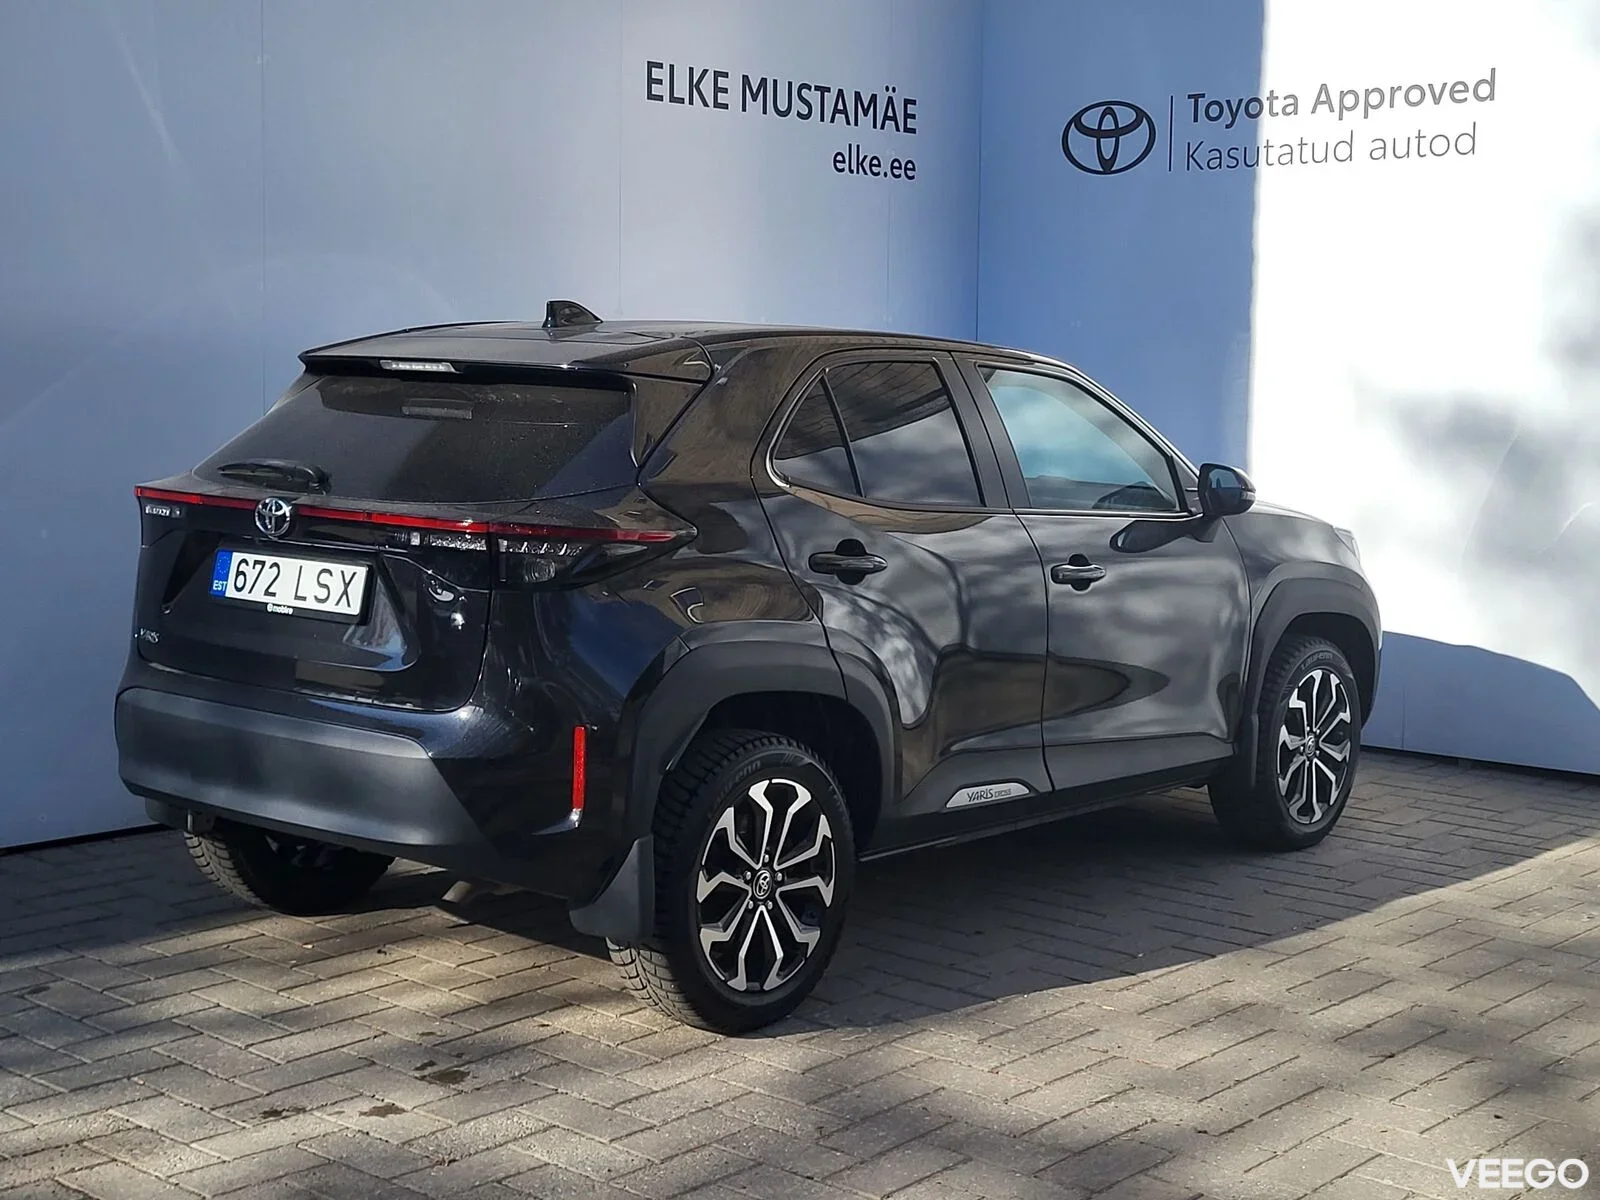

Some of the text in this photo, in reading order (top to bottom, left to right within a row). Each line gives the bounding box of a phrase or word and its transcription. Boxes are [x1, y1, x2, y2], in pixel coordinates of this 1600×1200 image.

[646, 60, 918, 135] ELKE MUSTAMÄE
[1187, 67, 1497, 130] Toyota Approved
[832, 143, 917, 181] elke.ee
[1185, 121, 1478, 173] Kasutatud autod
[213, 580, 227, 591] EST
[233, 558, 358, 608] 672 LSX
